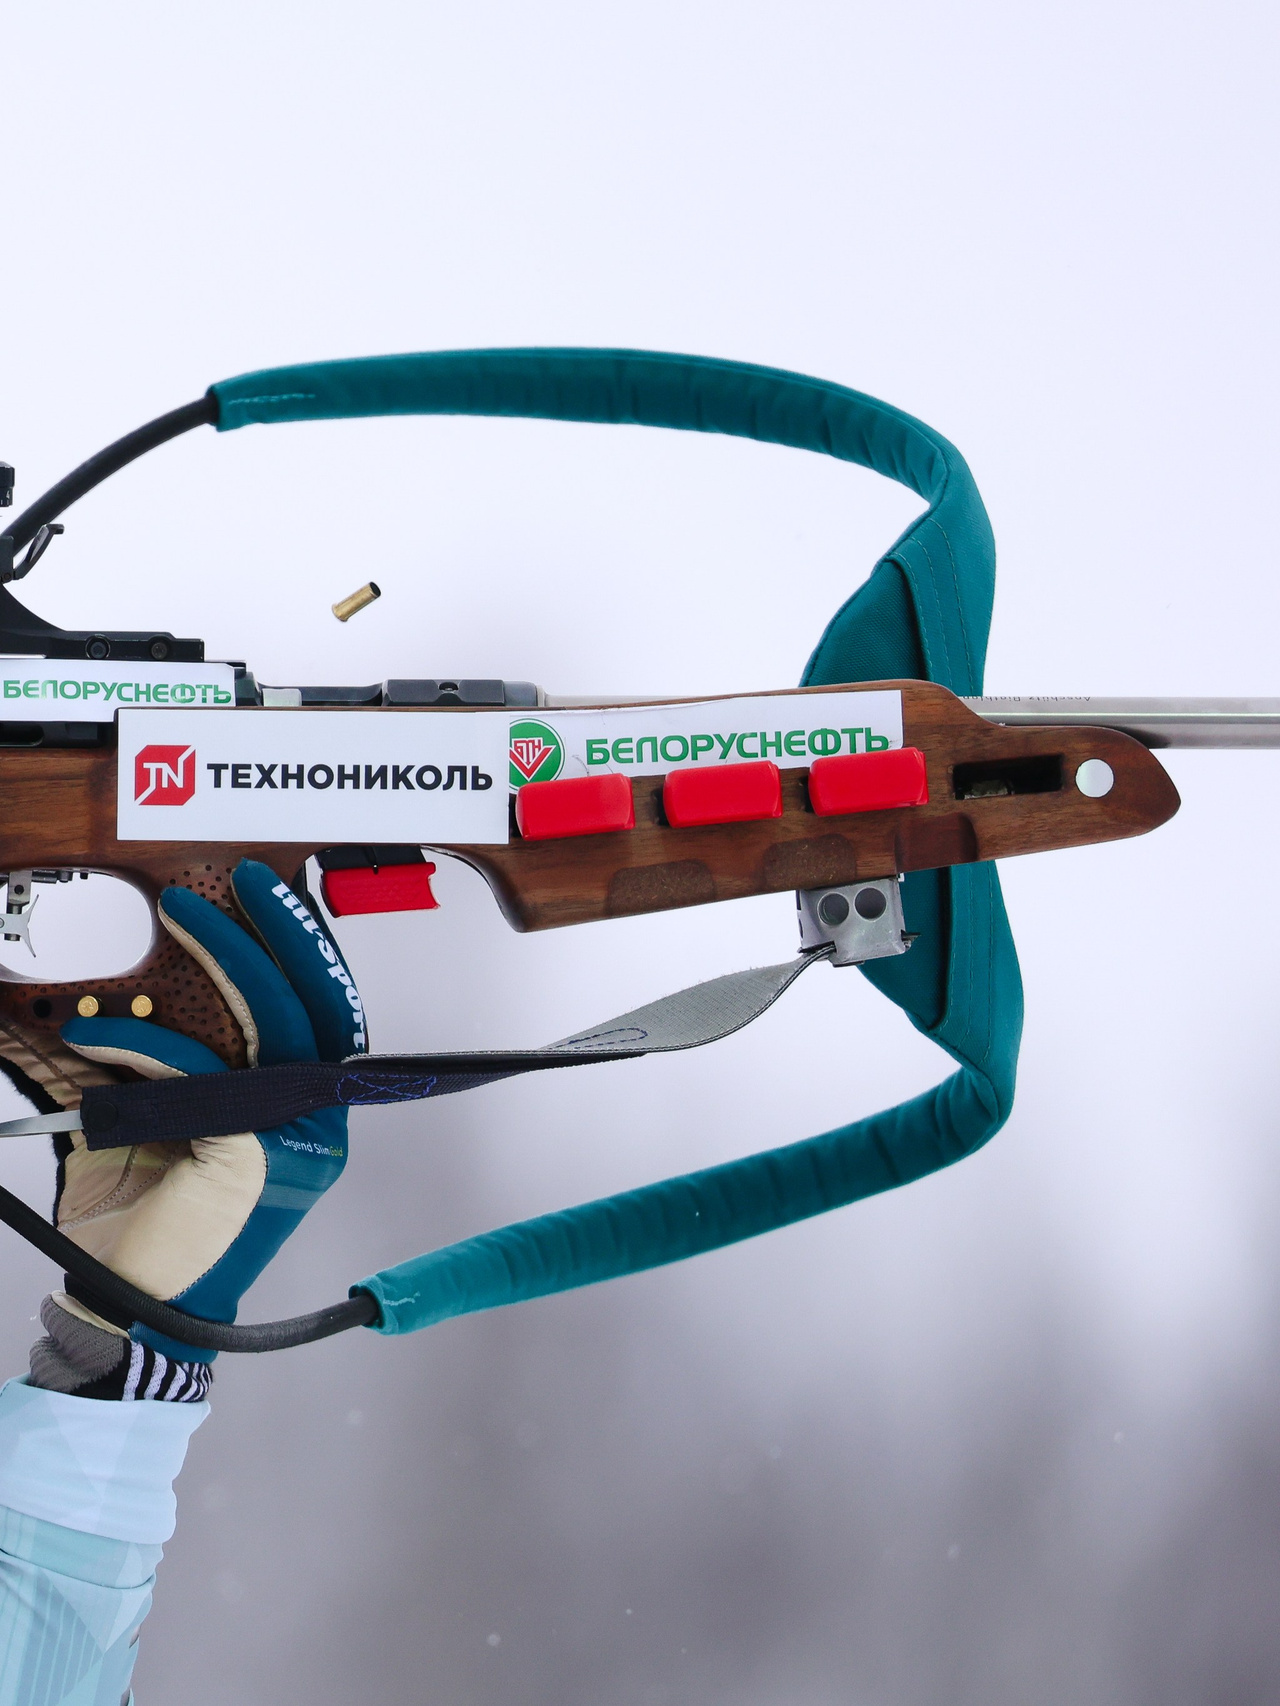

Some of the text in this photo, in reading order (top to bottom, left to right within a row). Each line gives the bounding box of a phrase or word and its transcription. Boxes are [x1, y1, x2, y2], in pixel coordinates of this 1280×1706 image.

[3, 679, 232, 704] БЕЛОРУСНЕФТЬ
[586, 727, 889, 766] БЕЛОРУСНЕФТЬ
[206, 762, 493, 791] ТЕХНОНИКОЛЬ
[279, 1135, 314, 1153] Legend
